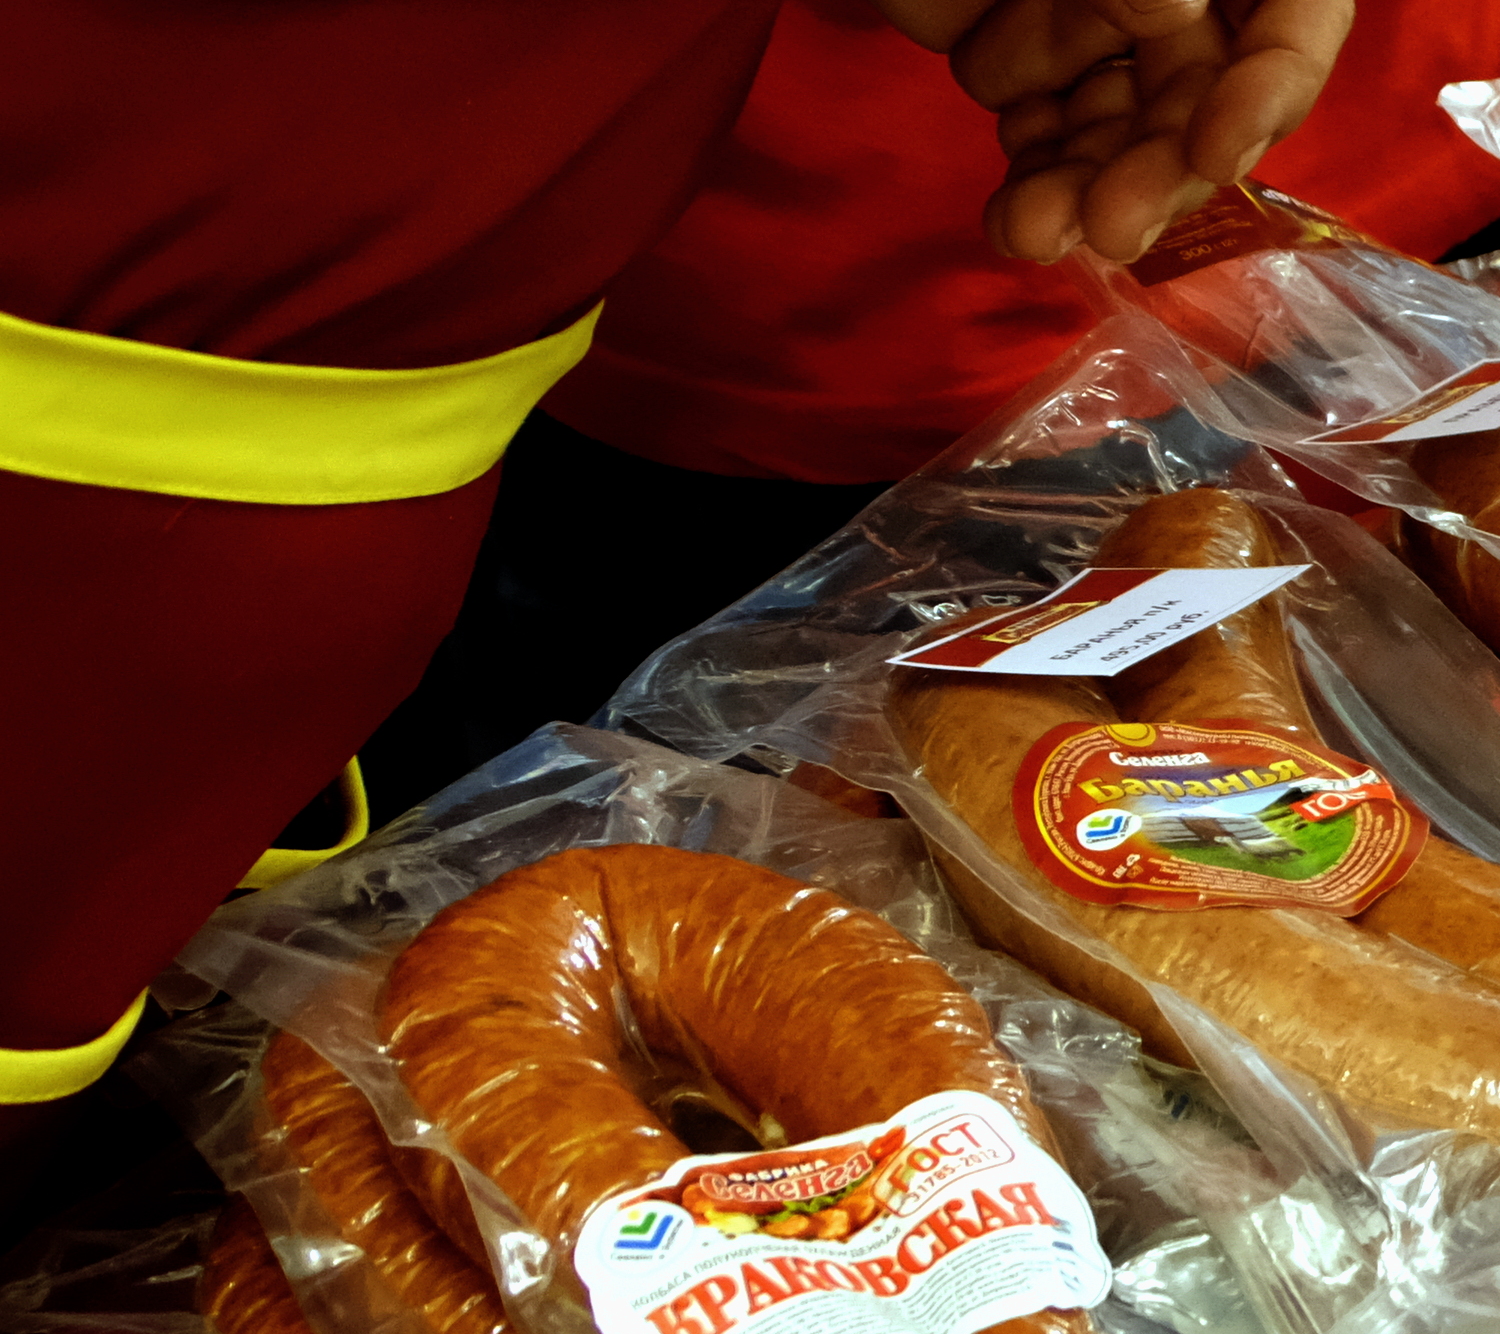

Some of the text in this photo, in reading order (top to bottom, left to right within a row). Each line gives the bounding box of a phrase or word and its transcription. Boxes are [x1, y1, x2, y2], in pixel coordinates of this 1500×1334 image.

[1049, 617, 1147, 662] БАРАНЬЯ
[1075, 758, 1309, 805] Баранья
[1108, 750, 1212, 769] Селенга
[700, 1155, 873, 1202] Селенга
[728, 1157, 829, 1183] ФАБРИКА
[886, 1121, 984, 1195] ГОСТ
